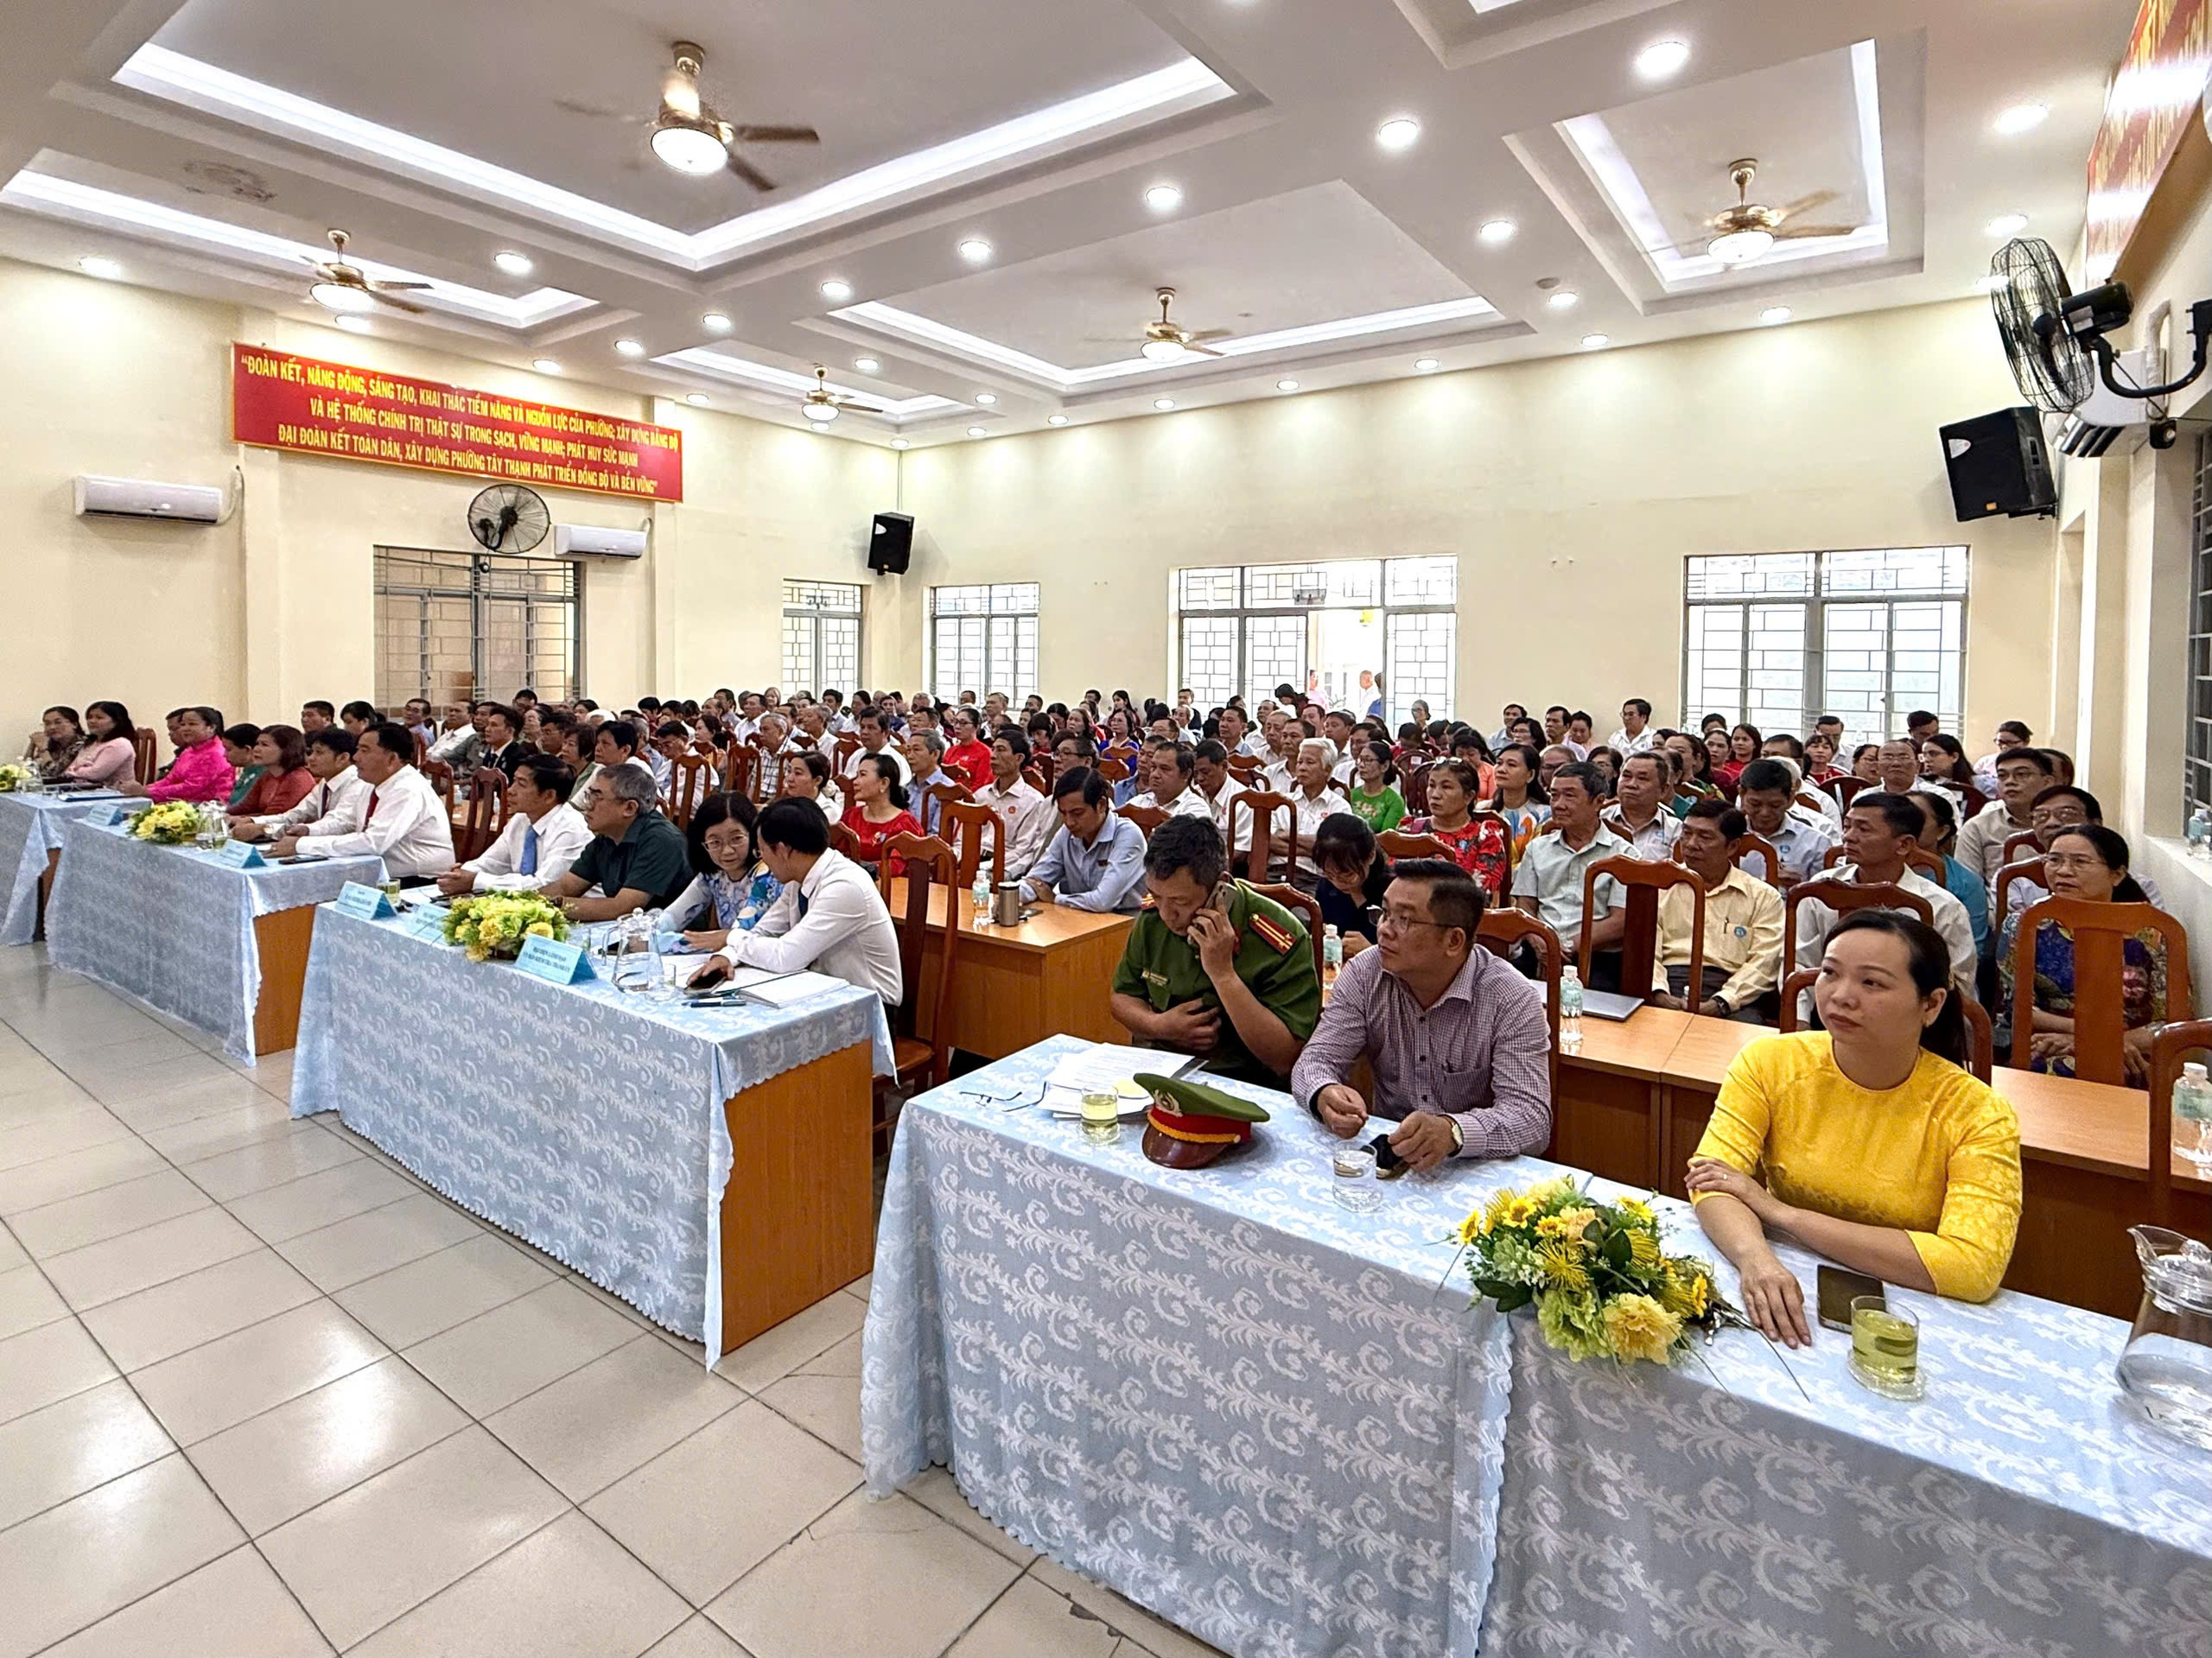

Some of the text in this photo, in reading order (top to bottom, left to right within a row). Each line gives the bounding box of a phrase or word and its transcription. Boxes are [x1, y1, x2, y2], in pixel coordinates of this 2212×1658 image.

[280, 356, 305, 386] KẾT,
[308, 365, 335, 389] NĂNG
[337, 369, 367, 397] ĐỘNG,
[369, 375, 395, 399] SÁNG
[396, 384, 417, 406] TẠO,
[419, 388, 441, 408] KHAI
[442, 391, 466, 412] THÁC
[513, 403, 524, 424] VÀ
[553, 412, 568, 433] LỰC
[569, 412, 584, 434] CỦA
[616, 422, 630, 441] XÂY
[310, 394, 324, 417] VÀ
[327, 397, 341, 422] HỆ
[343, 399, 377, 425] THỐNG
[378, 408, 407, 430] CHÍNH
[409, 415, 424, 437] TRỊ
[426, 416, 448, 440] THẬT
[450, 421, 463, 443] SỰ
[464, 424, 493, 445] TRONG
[493, 430, 518, 452] SẠCH,
[518, 431, 540, 453] VỮNG
[567, 439, 586, 459] PHÁT
[588, 445, 601, 461] HUY
[603, 445, 617, 464] SỨC
[619, 449, 638, 468] MẠNH
[278, 423, 296, 447] ĐẠI
[300, 424, 327, 448] ĐOÀN
[330, 426, 350, 451] KẾT
[352, 432, 378, 455] TOÀN
[380, 436, 403, 462] DÂN,
[405, 439, 423, 461] XÂY
[425, 444, 449, 467] DỰNG
[451, 448, 485, 471] PHƯỜNG
[486, 452, 503, 473] TÂY
[504, 458, 531, 479] THẠNH
[532, 460, 553, 480] PHÁT
[554, 460, 576, 484] TRIỂN
[599, 469, 608, 491] BỘ
[610, 470, 620, 490] VÀ
